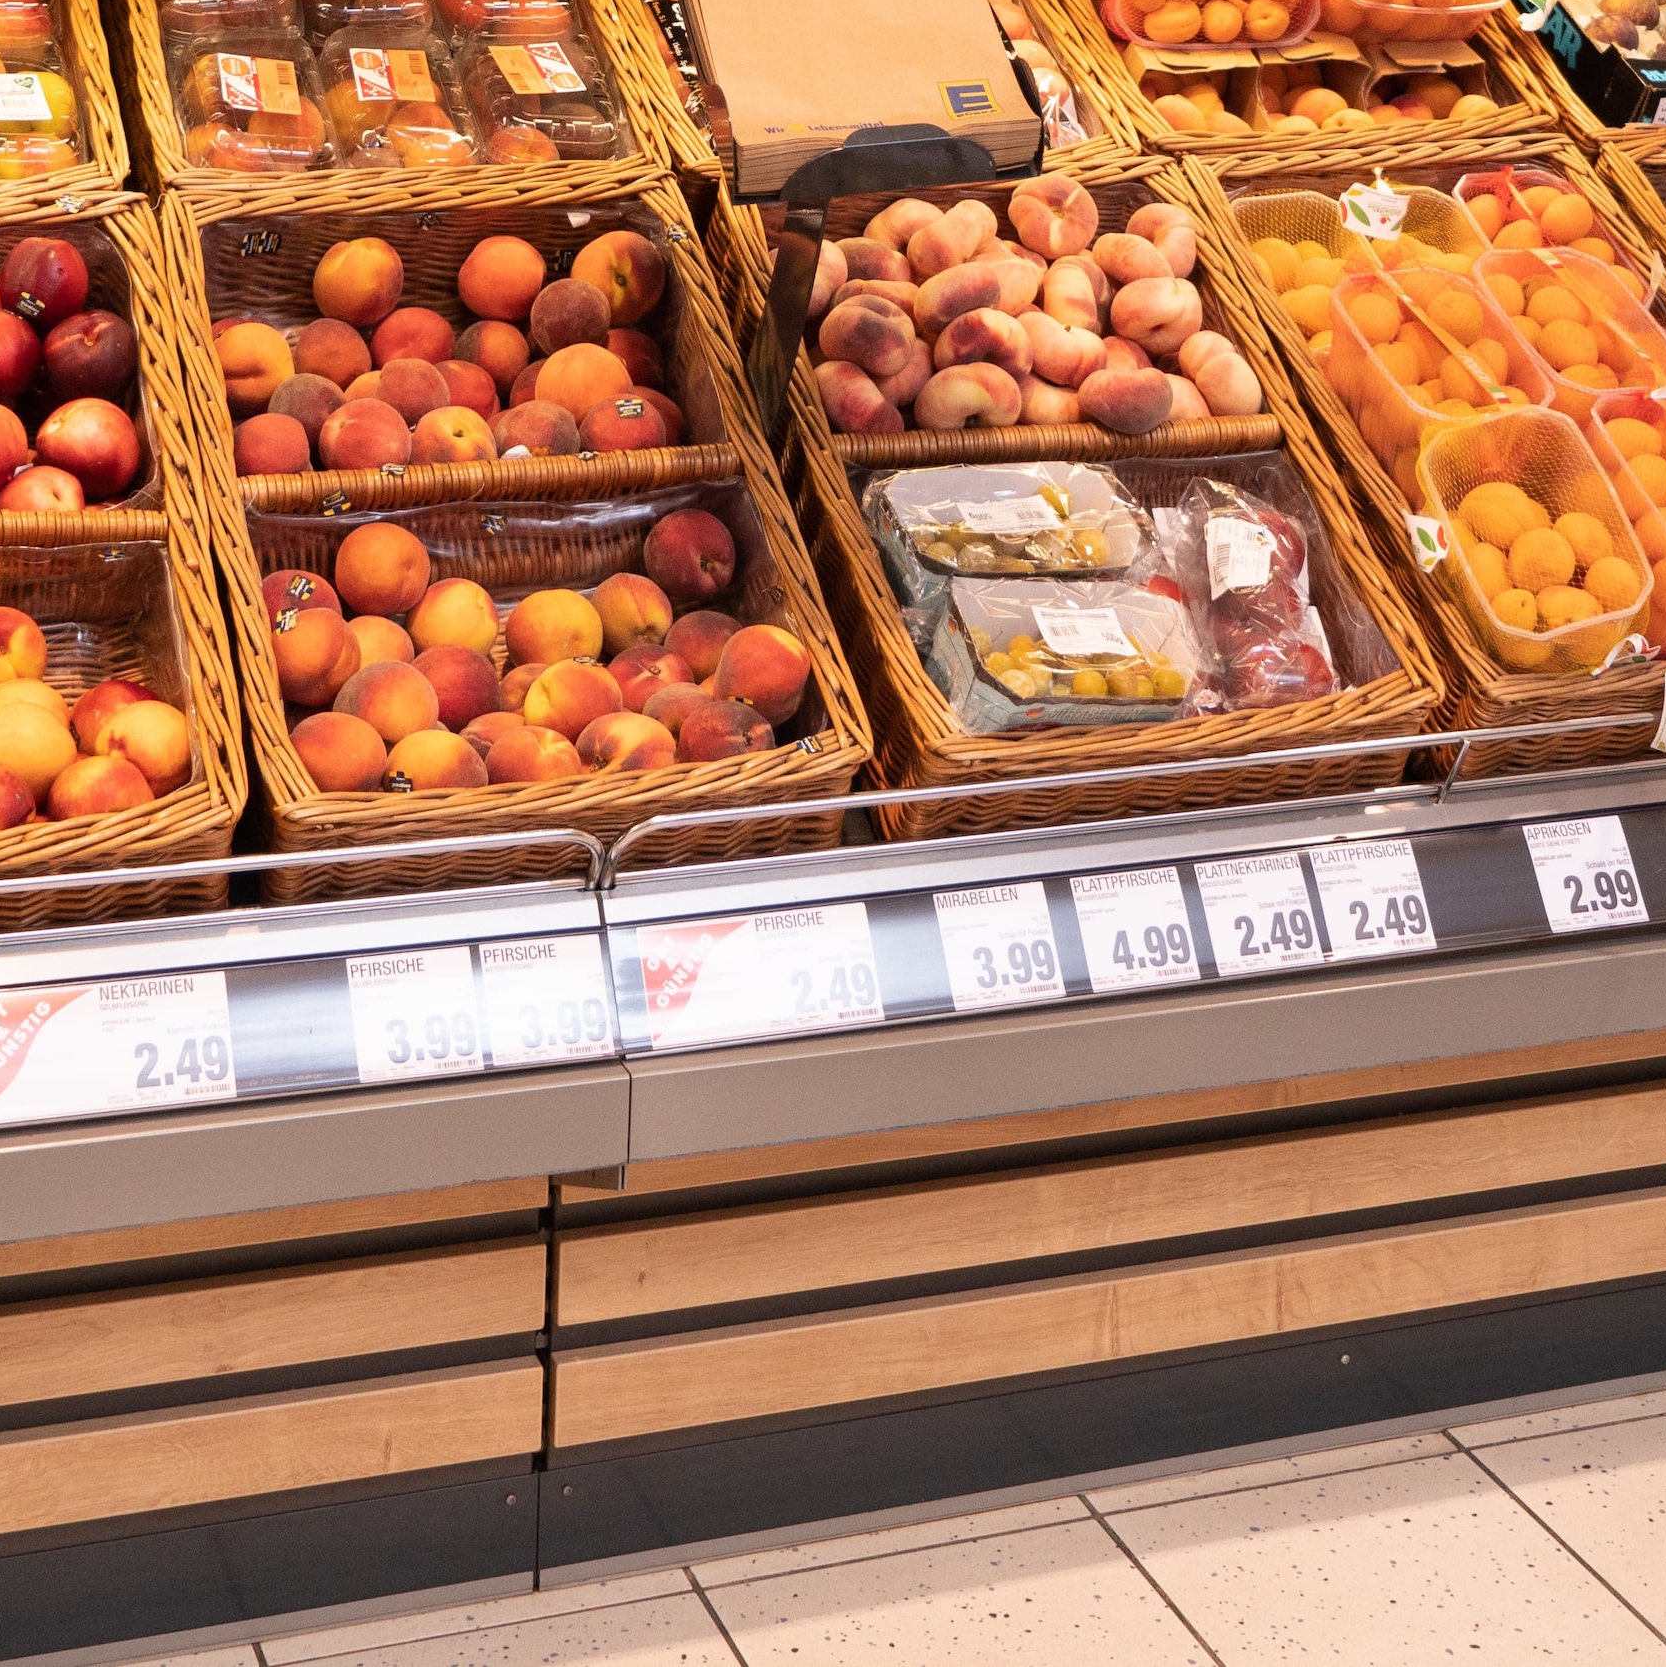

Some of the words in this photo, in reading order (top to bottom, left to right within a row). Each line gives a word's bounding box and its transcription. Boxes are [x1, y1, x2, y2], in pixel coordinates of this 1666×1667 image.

[1527, 821, 1592, 840] APRIKOSEN
[1196, 855, 1300, 880] PLATTNEKTARINEN
[1313, 842, 1411, 865] PLATTPFIRSICHE
[936, 887, 1019, 910] MIRABELLEN
[1073, 869, 1176, 893] PLATTPFIRSICHE
[1563, 869, 1638, 914] 2.99
[754, 912, 824, 932] PFIRSICHE
[1234, 909, 1314, 957] 2.49
[1349, 894, 1427, 940] 2.49
[350, 957, 425, 979] PFIRSICHE
[483, 944, 556, 964] PFIRSICHE
[656, 931, 714, 1008] GÜNSTIG
[973, 939, 1055, 989] 3.99
[1112, 923, 1191, 971] 4.99
[99, 978, 194, 1002] NEKTARINEN
[791, 963, 876, 1013] 2.49
[385, 1012, 476, 1064] 3.99
[518, 998, 607, 1048] 3.99
[133, 1035, 229, 1089] 2.49
